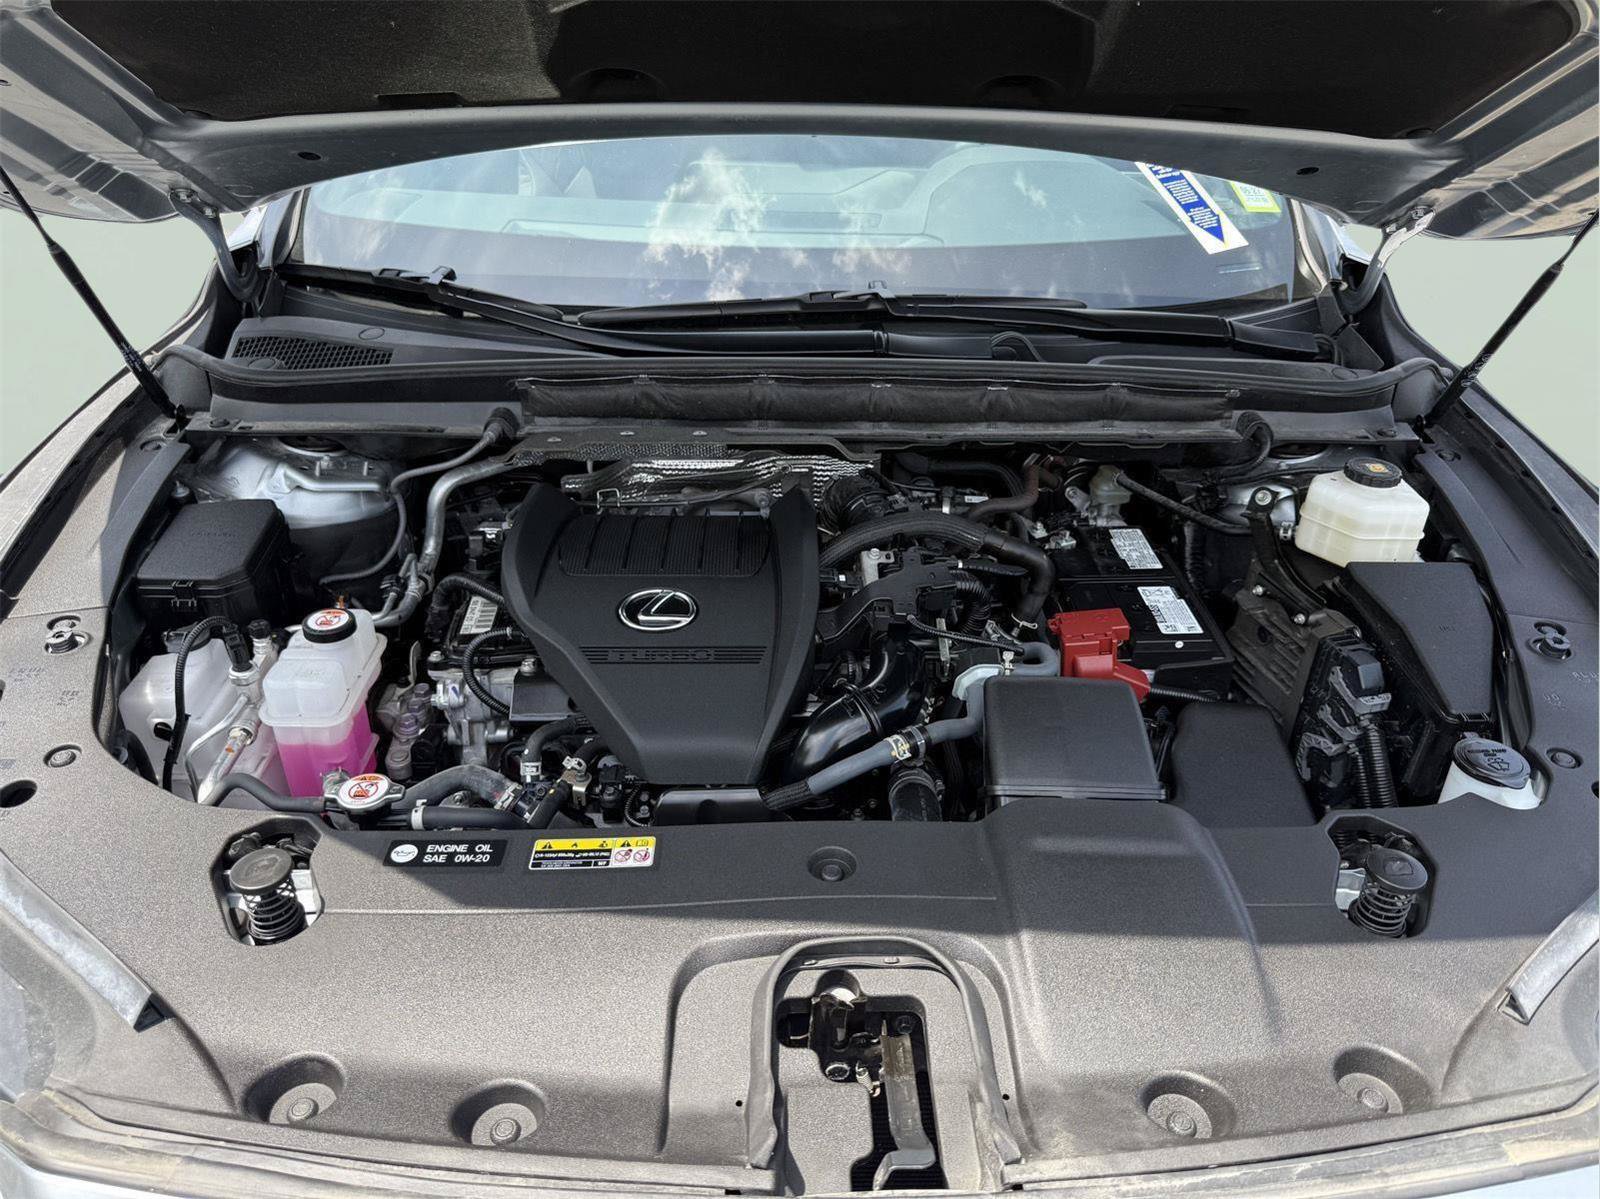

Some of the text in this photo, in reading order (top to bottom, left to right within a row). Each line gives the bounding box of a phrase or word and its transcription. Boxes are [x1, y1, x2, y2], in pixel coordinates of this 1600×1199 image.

[610, 648, 713, 661] TURBO
[426, 843, 494, 853] ENGINE OIL
[422, 854, 491, 863] SAE 0W-20
